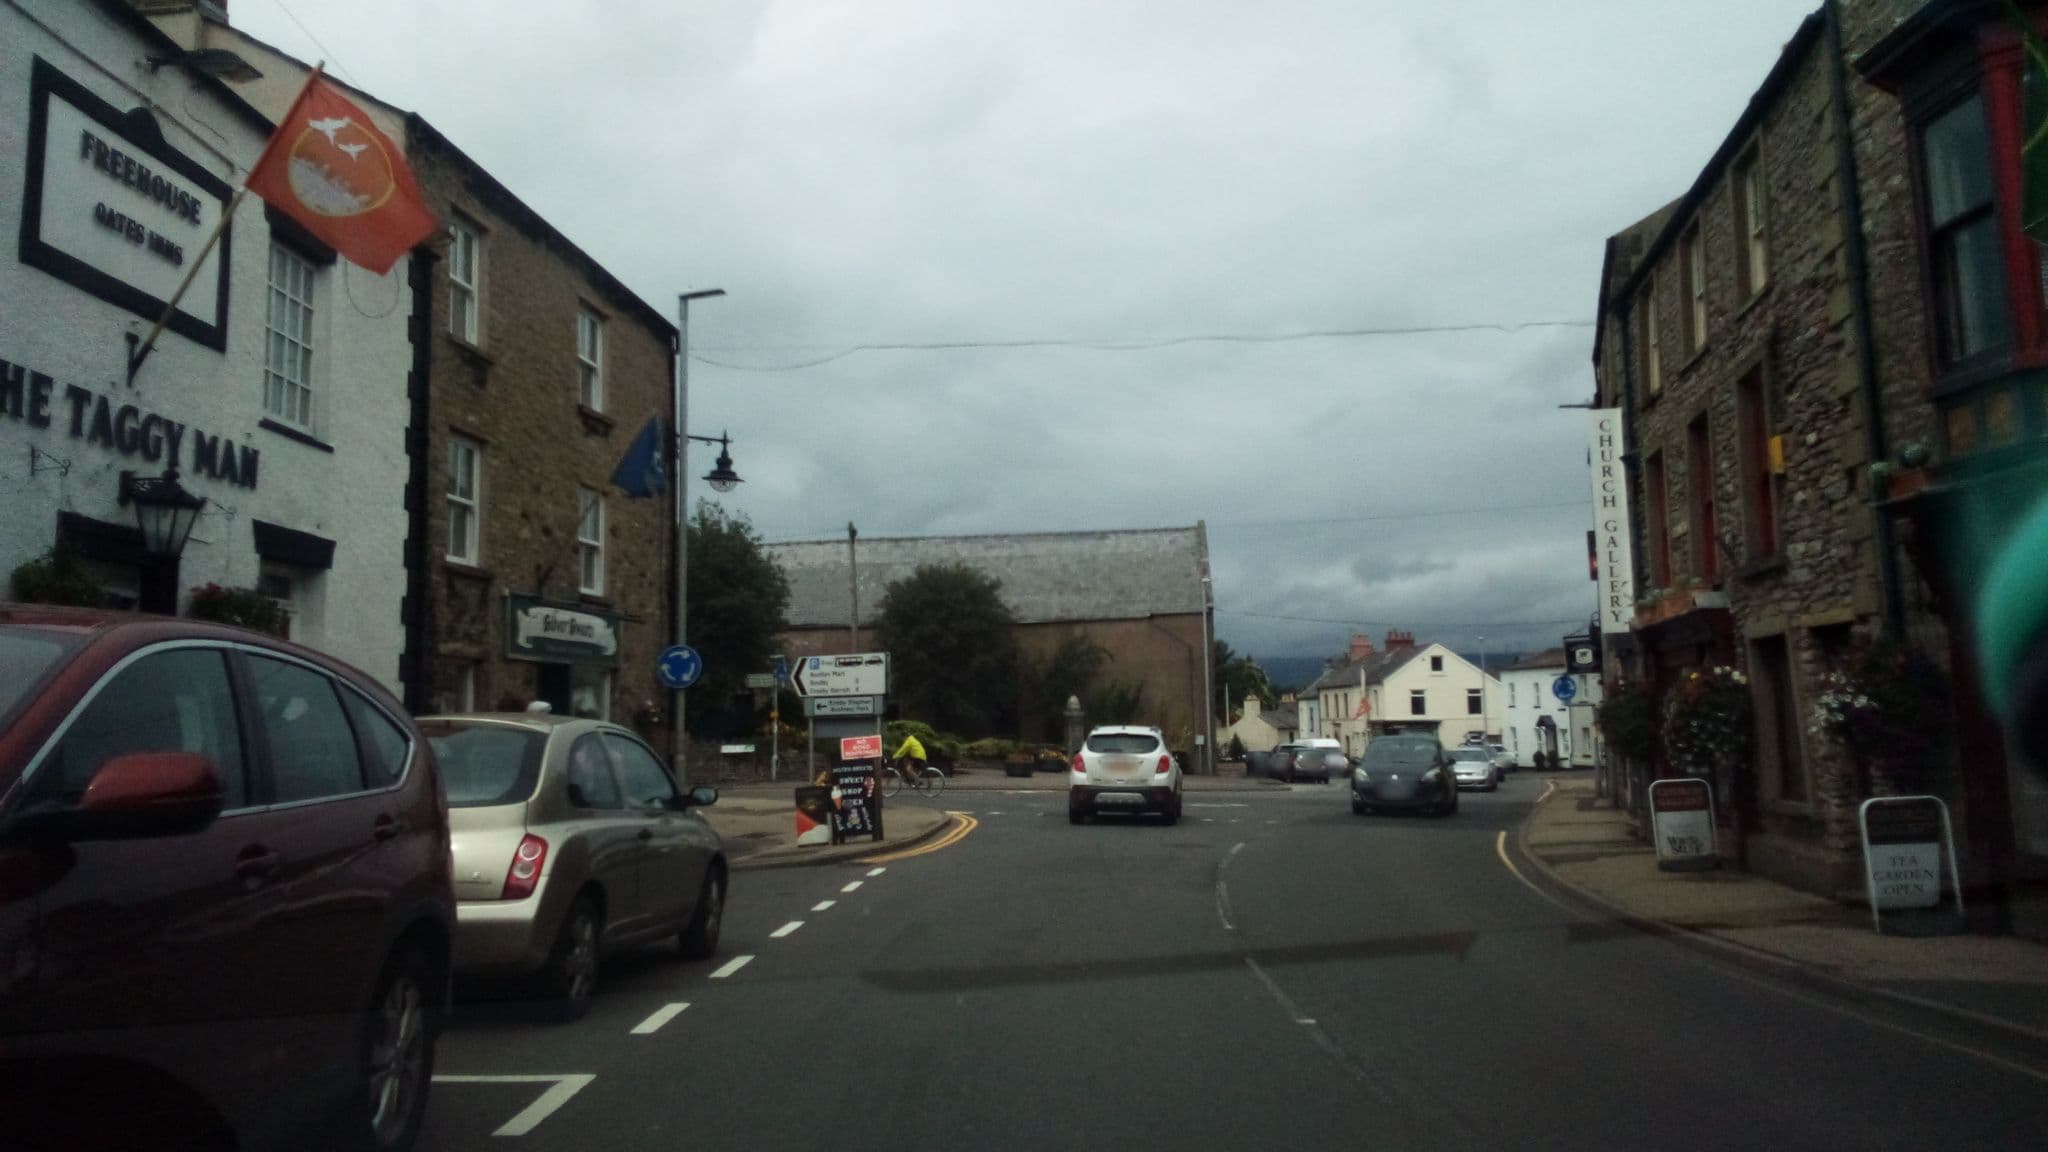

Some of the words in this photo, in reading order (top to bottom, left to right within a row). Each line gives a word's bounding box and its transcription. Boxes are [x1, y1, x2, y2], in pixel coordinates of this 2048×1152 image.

[82, 129, 202, 226] FREEHOUSE
[0, 359, 53, 430] HE
[66, 383, 186, 467] TAGGY
[193, 428, 260, 490] MAN
[1599, 418, 1616, 508] CHURCH
[1604, 519, 1622, 624] GALLERY
[840, 776, 865, 785] SWEET
[841, 788, 863, 796] SHOP
